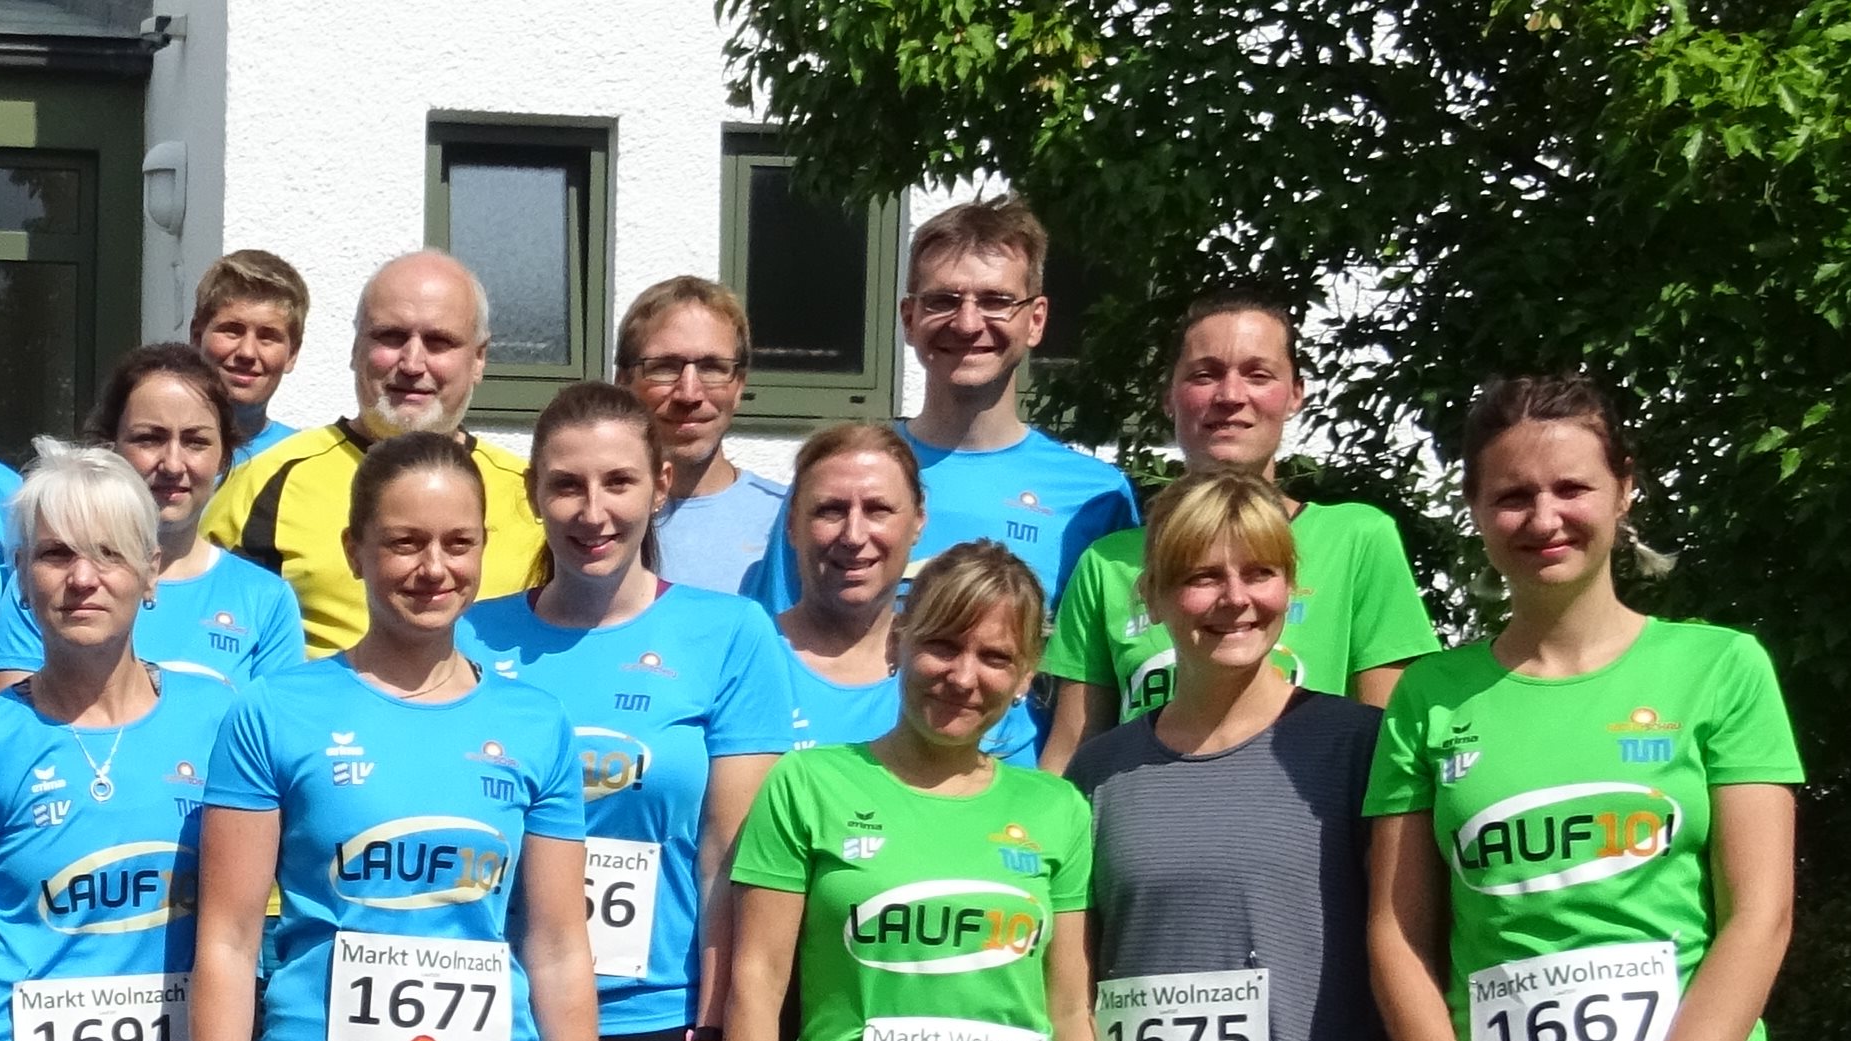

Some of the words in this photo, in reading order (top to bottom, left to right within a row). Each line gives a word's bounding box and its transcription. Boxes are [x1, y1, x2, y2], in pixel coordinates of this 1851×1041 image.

[1006, 520, 1039, 544] TUM
[208, 632, 240, 654] TUM
[614, 693, 651, 712] TUM
[1618, 737, 1672, 762] TUM
[480, 775, 515, 802] TUM
[1452, 811, 1675, 871] LAUF10!
[335, 840, 508, 895] LAUF10!
[850, 903, 1044, 957] LAUF10!
[342, 945, 409, 967] Markt
[416, 948, 502, 973] Wolnzach
[1476, 972, 1538, 1003] Markt
[1544, 956, 1664, 987] Wolnzach
[22, 990, 85, 1010] Markt
[92, 983, 186, 1006] Wolnzach
[348, 976, 497, 1032] 1677
[1100, 989, 1147, 1011] Markt
[1152, 981, 1259, 1005] Wolnzach
